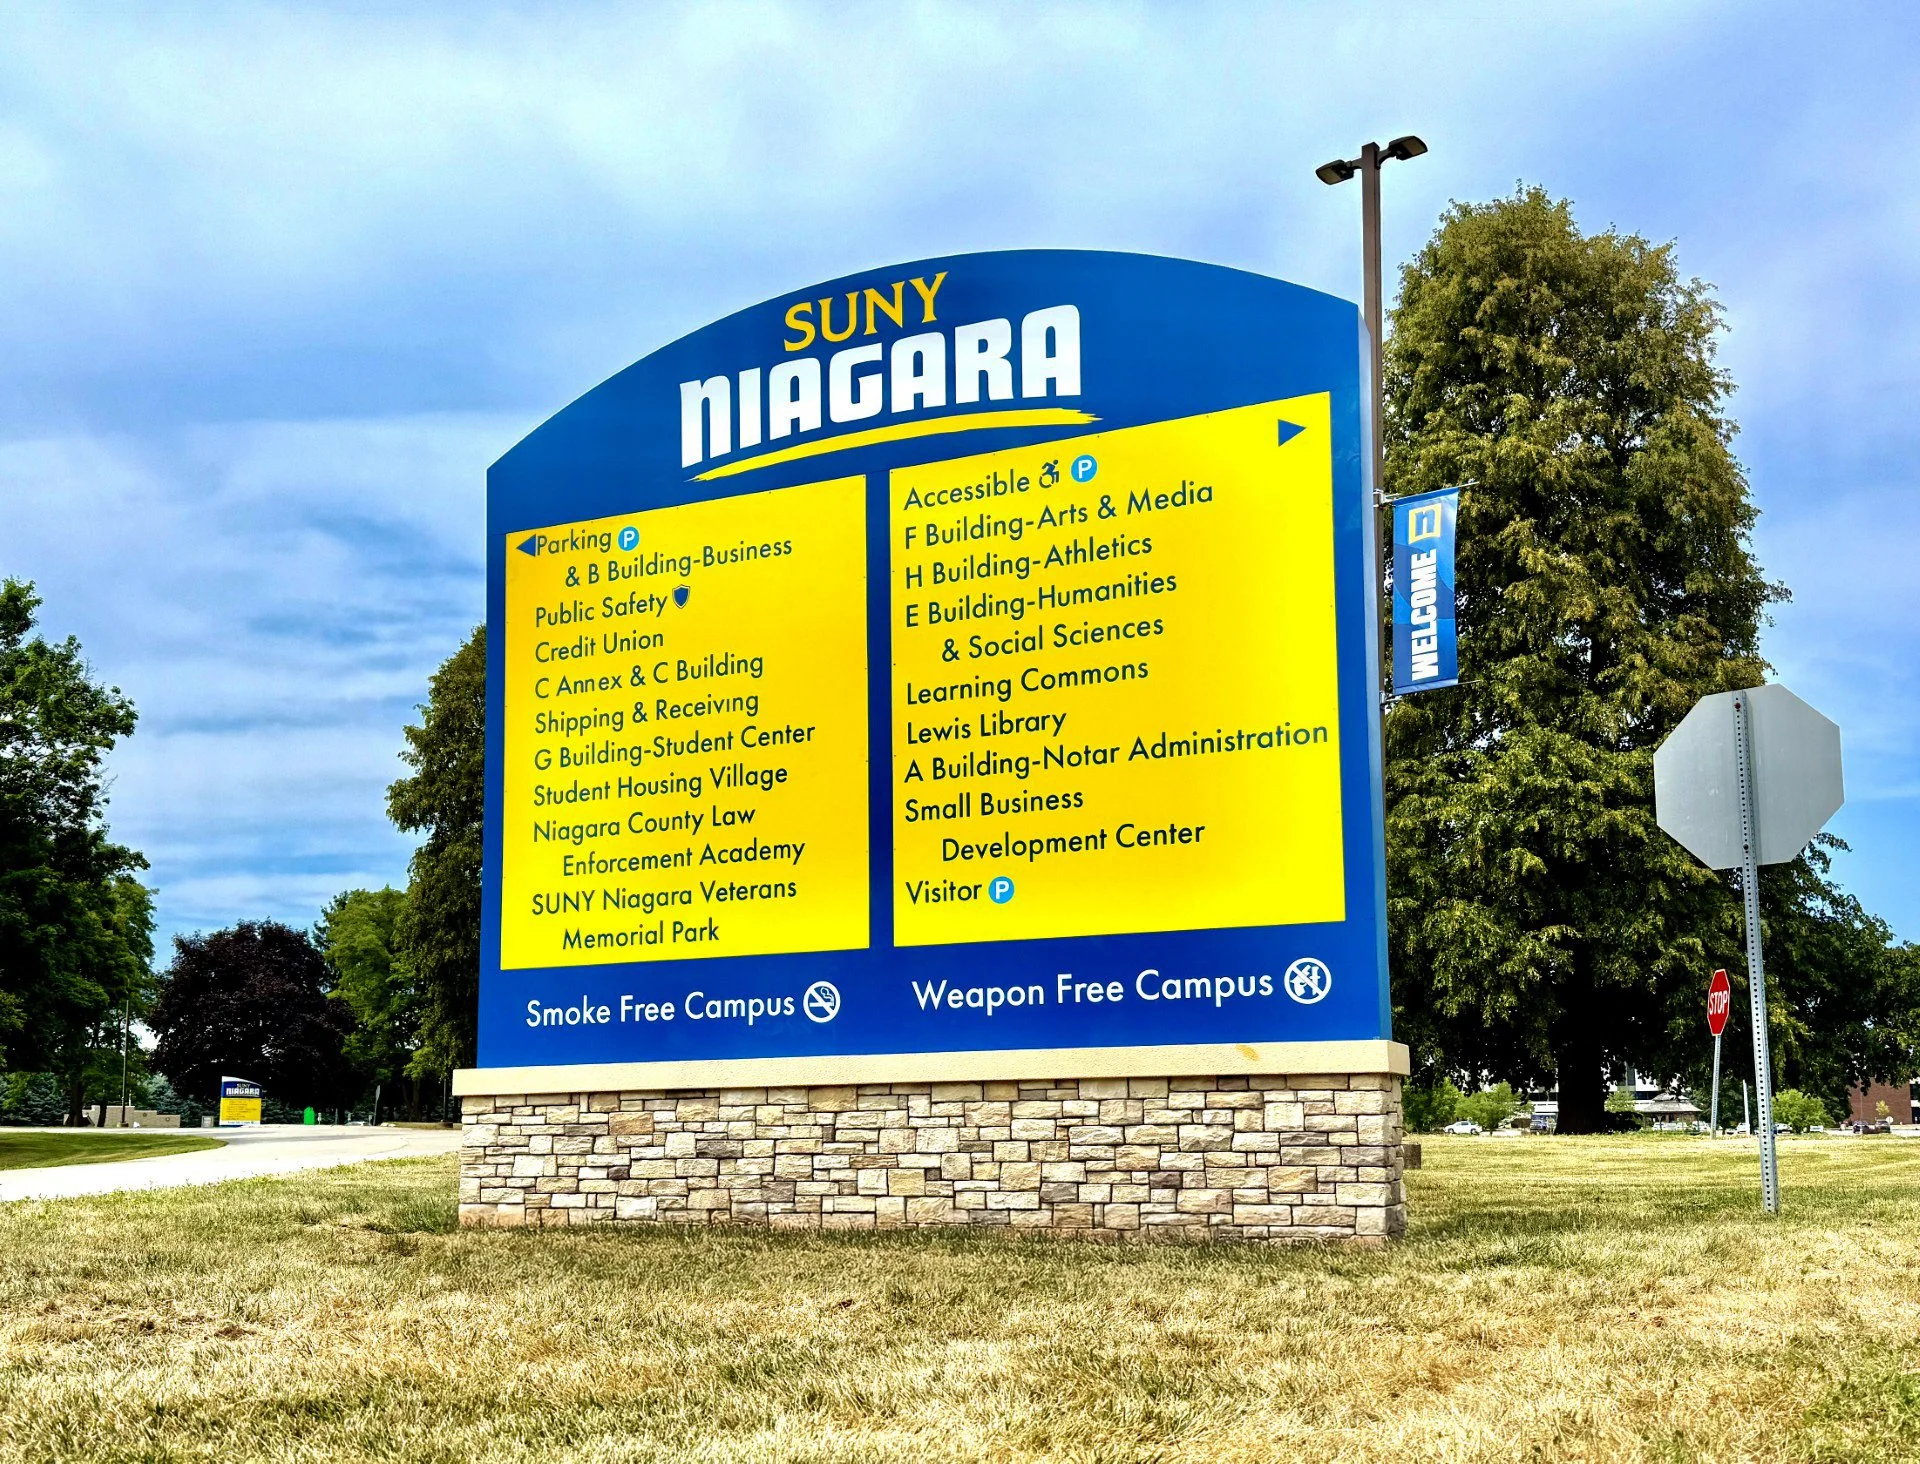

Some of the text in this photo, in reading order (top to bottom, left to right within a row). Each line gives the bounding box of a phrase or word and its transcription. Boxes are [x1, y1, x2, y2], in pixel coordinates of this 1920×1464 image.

[785, 272, 947, 351] SUNY
[904, 469, 1029, 510] Accessible
[906, 480, 1212, 549] F Building-Arts & Media
[537, 529, 611, 555] Parking
[906, 534, 1152, 589] H Building-Athletics
[566, 540, 791, 587] & B Building-Business
[536, 591, 667, 627] Public Safety
[907, 571, 1176, 627] E Building-Humanities
[1411, 549, 1439, 681] WELCOME
[536, 630, 663, 662] Credit Union
[942, 619, 1163, 662] & Social Sciences
[535, 652, 762, 698] C Annex & C Building
[908, 663, 1148, 704] Learning Commons
[536, 694, 758, 737] Shipping & Receiving
[908, 710, 1066, 744] Lewis Library
[535, 725, 815, 770] G Building-Student Center
[904, 722, 1327, 783] A Building-Notar Administration
[534, 763, 787, 806] Student Housing Village
[534, 805, 755, 845] Niagara County Law
[906, 790, 1083, 822] Small Business
[564, 837, 805, 876] Enforcement Academy
[943, 824, 1205, 862] Development Center
[532, 881, 796, 915] SUNY Niagara Veterans
[906, 880, 982, 904] Visitor
[563, 917, 719, 949] Memorial Park
[527, 992, 794, 1026] Smoke Free Campus
[912, 970, 1272, 1015] Weapon Free Campus
[1709, 990, 1728, 1015] STOP
[226, 1087, 260, 1095] NIAGARA
